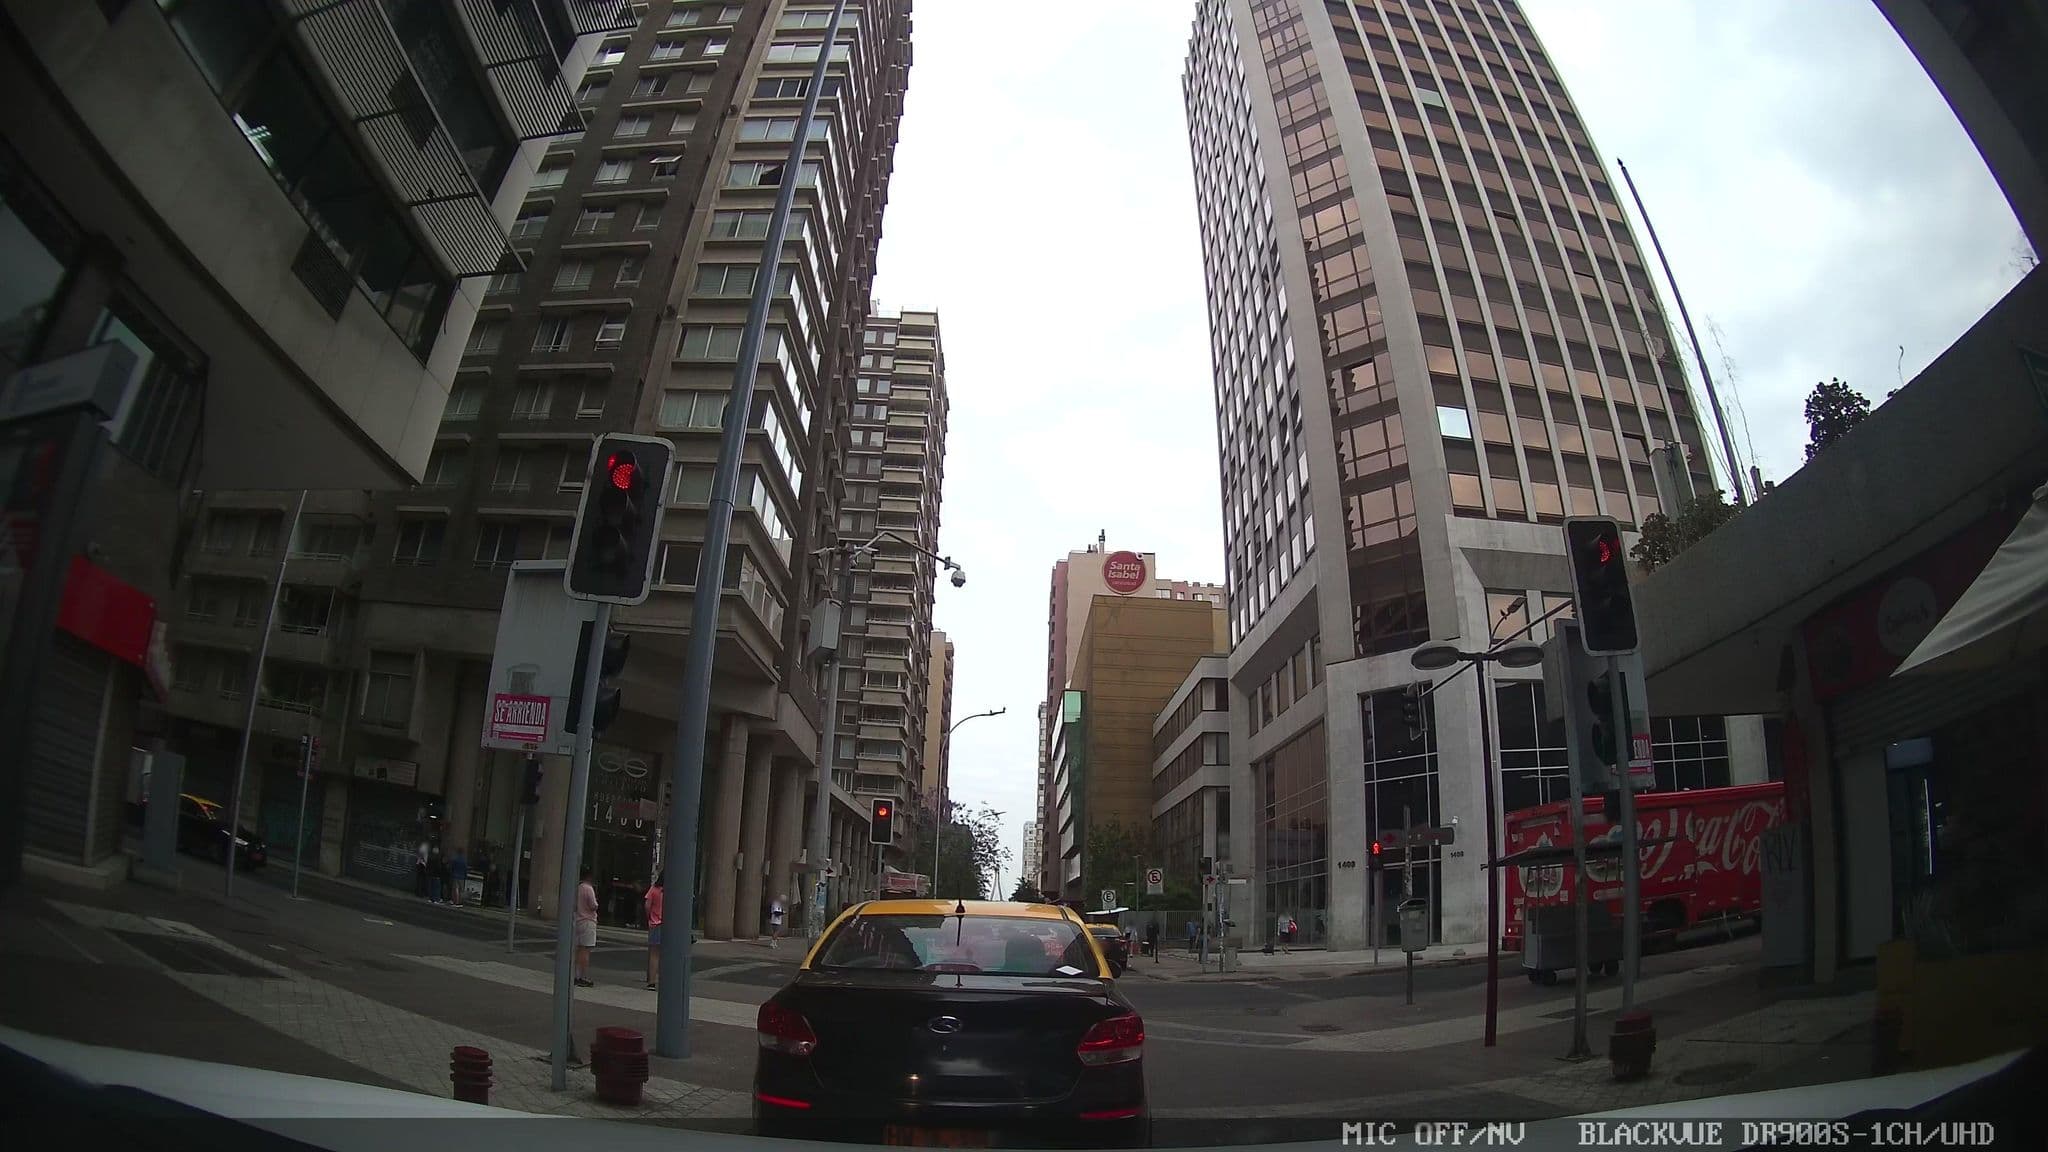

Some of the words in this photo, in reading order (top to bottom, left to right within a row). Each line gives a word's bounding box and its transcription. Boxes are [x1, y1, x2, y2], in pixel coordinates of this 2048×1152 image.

[1110, 561, 1141, 571] Santa
[1108, 570, 1140, 579] Isabel
[495, 700, 506, 721] SE
[506, 701, 547, 726] ARRIENDA
